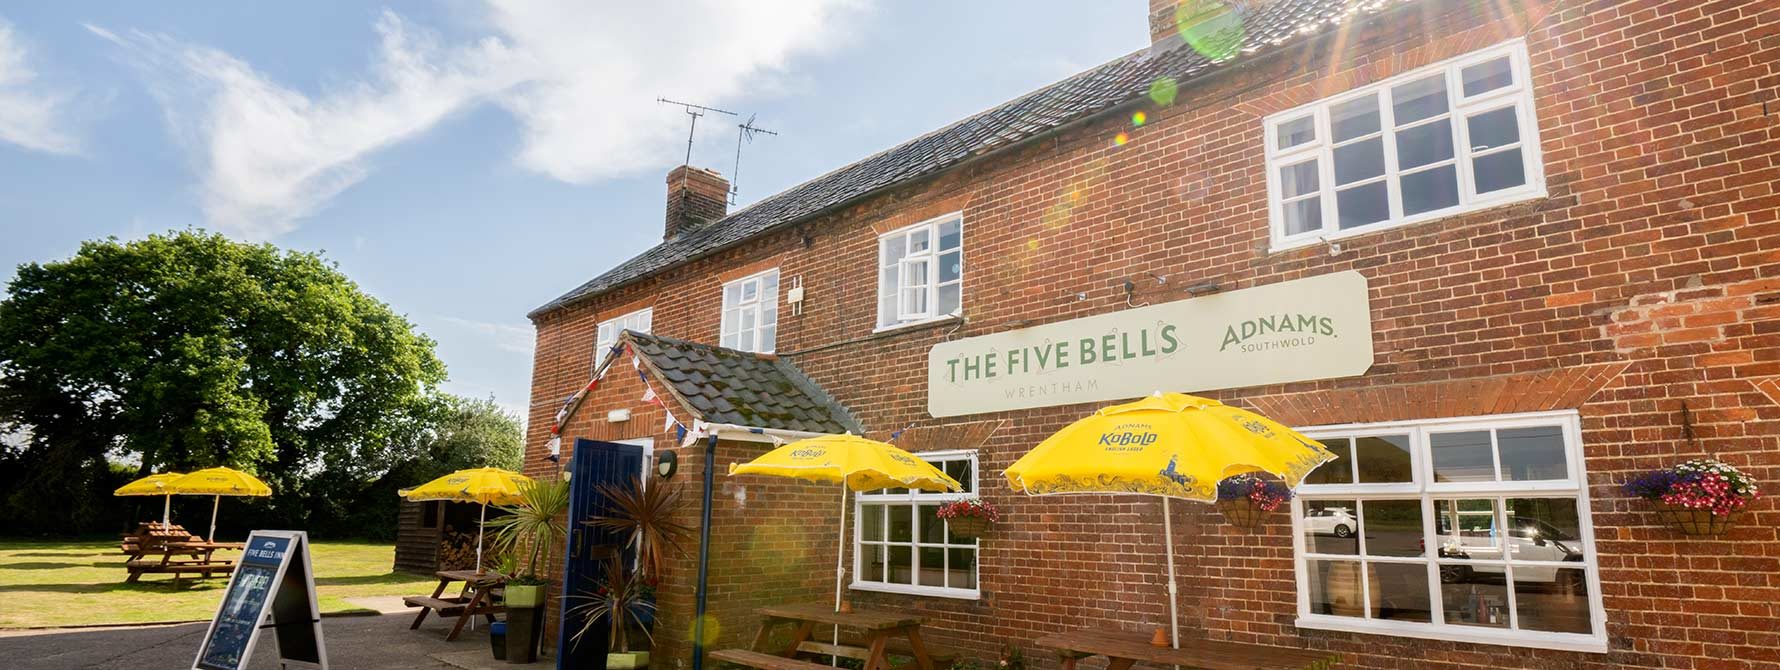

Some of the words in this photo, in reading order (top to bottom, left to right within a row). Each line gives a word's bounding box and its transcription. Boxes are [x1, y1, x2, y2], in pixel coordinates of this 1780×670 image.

[946, 352, 997, 383] THE
[1007, 341, 1070, 375] FIVE
[1079, 324, 1179, 366] BELLS
[1240, 336, 1315, 353] SOUTHWOLD
[1004, 379, 1099, 400] WRENTHAM
[247, 548, 260, 557] FIVE
[259, 550, 275, 559] BELLS
